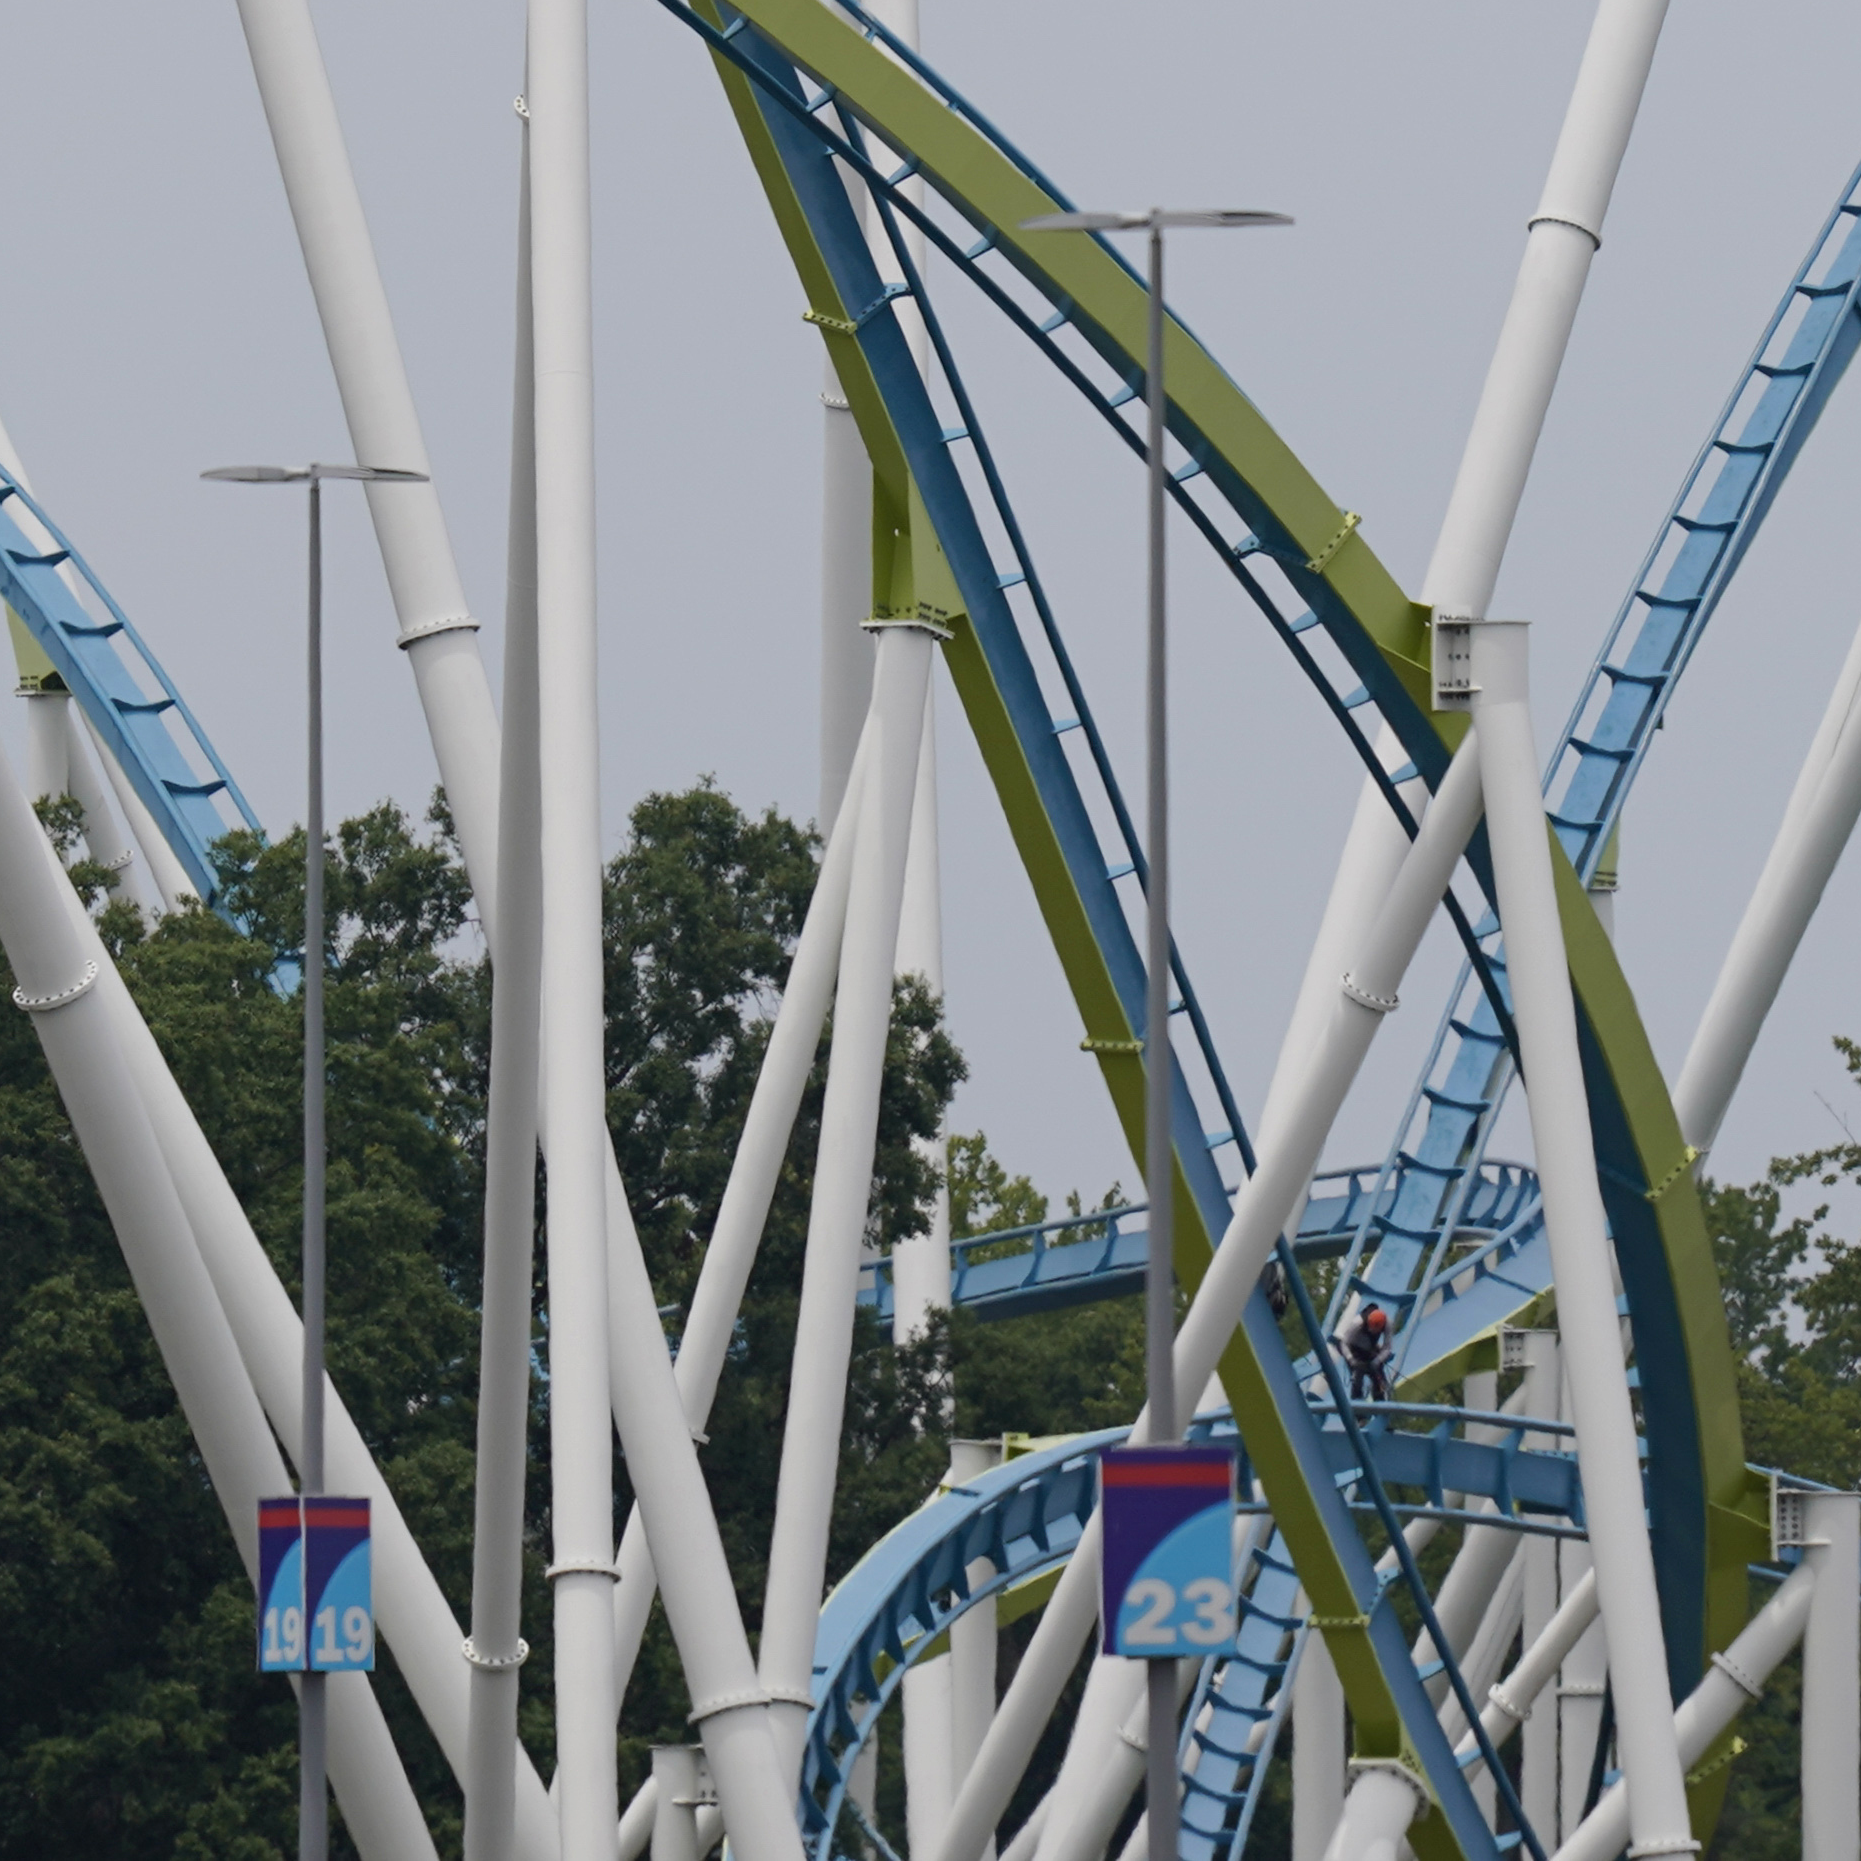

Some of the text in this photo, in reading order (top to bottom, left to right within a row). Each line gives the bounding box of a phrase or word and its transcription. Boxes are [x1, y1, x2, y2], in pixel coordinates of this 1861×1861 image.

[264, 1606, 303, 1663] 19
[316, 1606, 372, 1663] 19
[1124, 1578, 1235, 1645] 23
